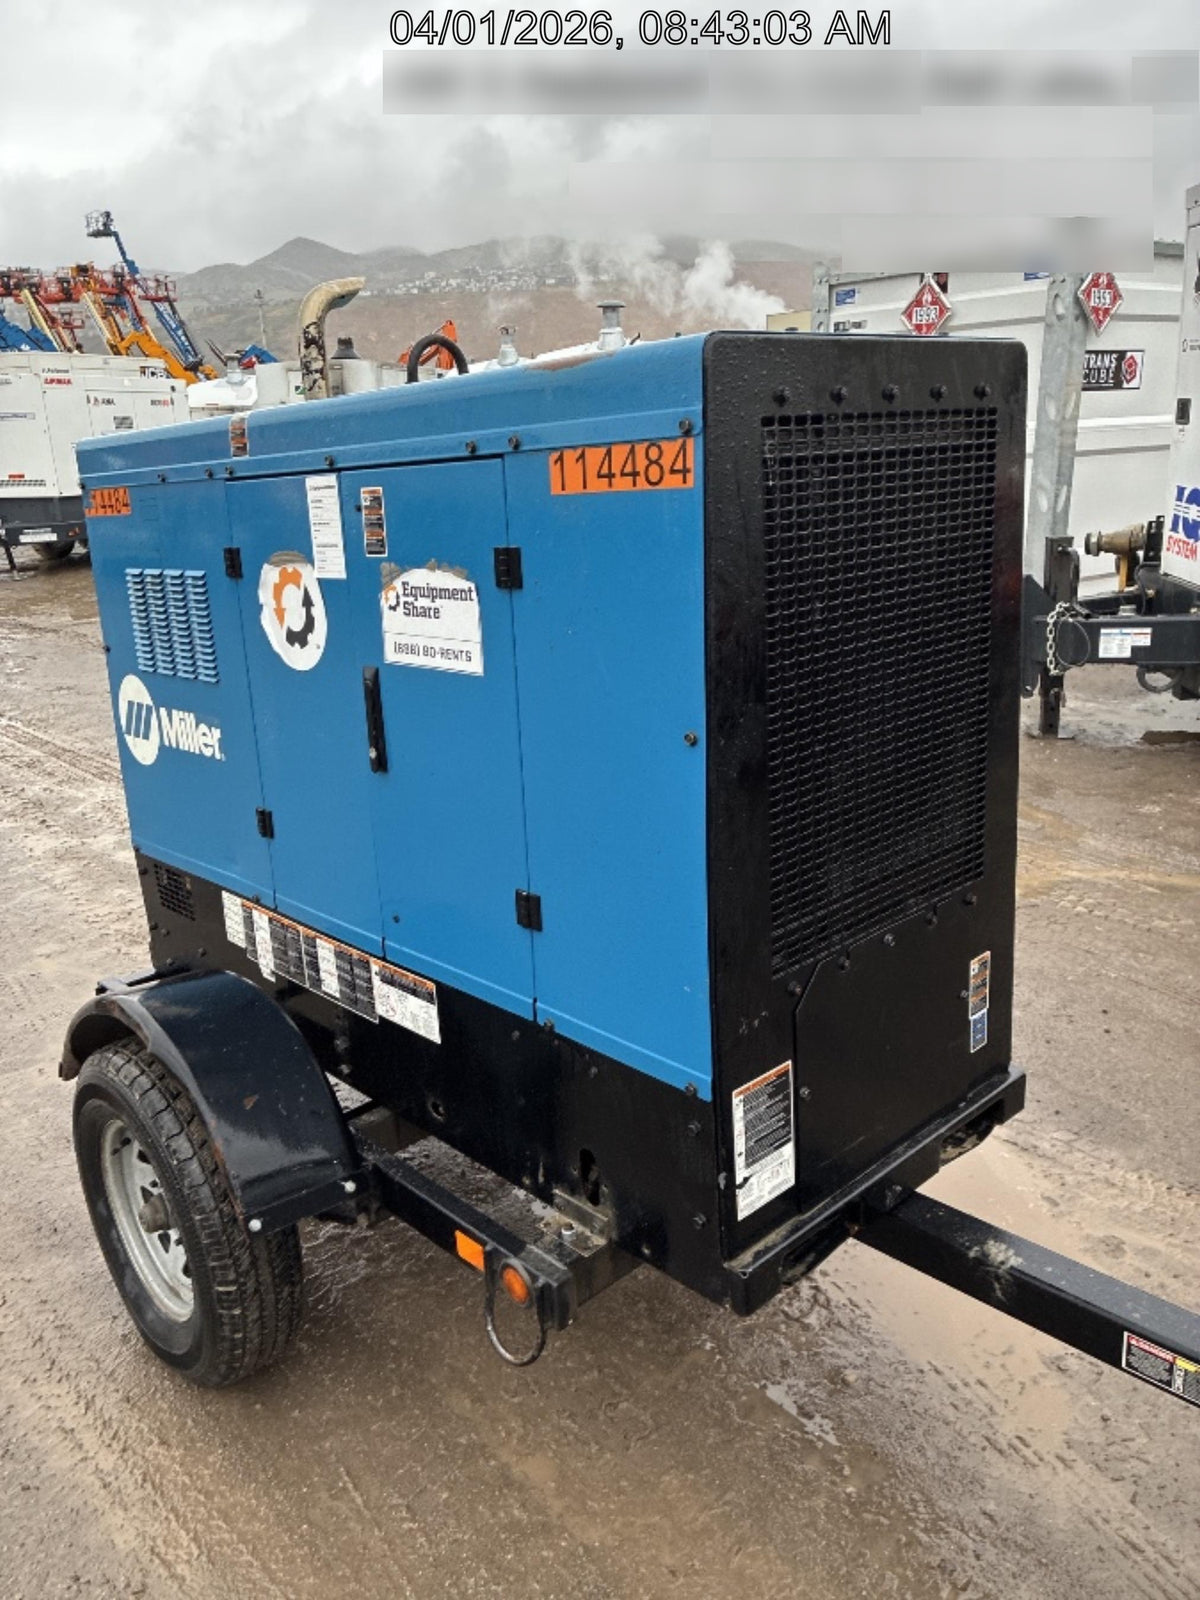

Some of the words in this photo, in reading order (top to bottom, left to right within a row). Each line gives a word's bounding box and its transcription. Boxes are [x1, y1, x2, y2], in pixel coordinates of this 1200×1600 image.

[1083, 353, 1117, 369] TRANS
[1082, 368, 1115, 384] CUBE
[553, 438, 691, 491] 114484
[87, 487, 130, 515] 14484
[401, 580, 475, 603] Equipment
[402, 601, 441, 620] Share
[159, 706, 222, 761] Miller
